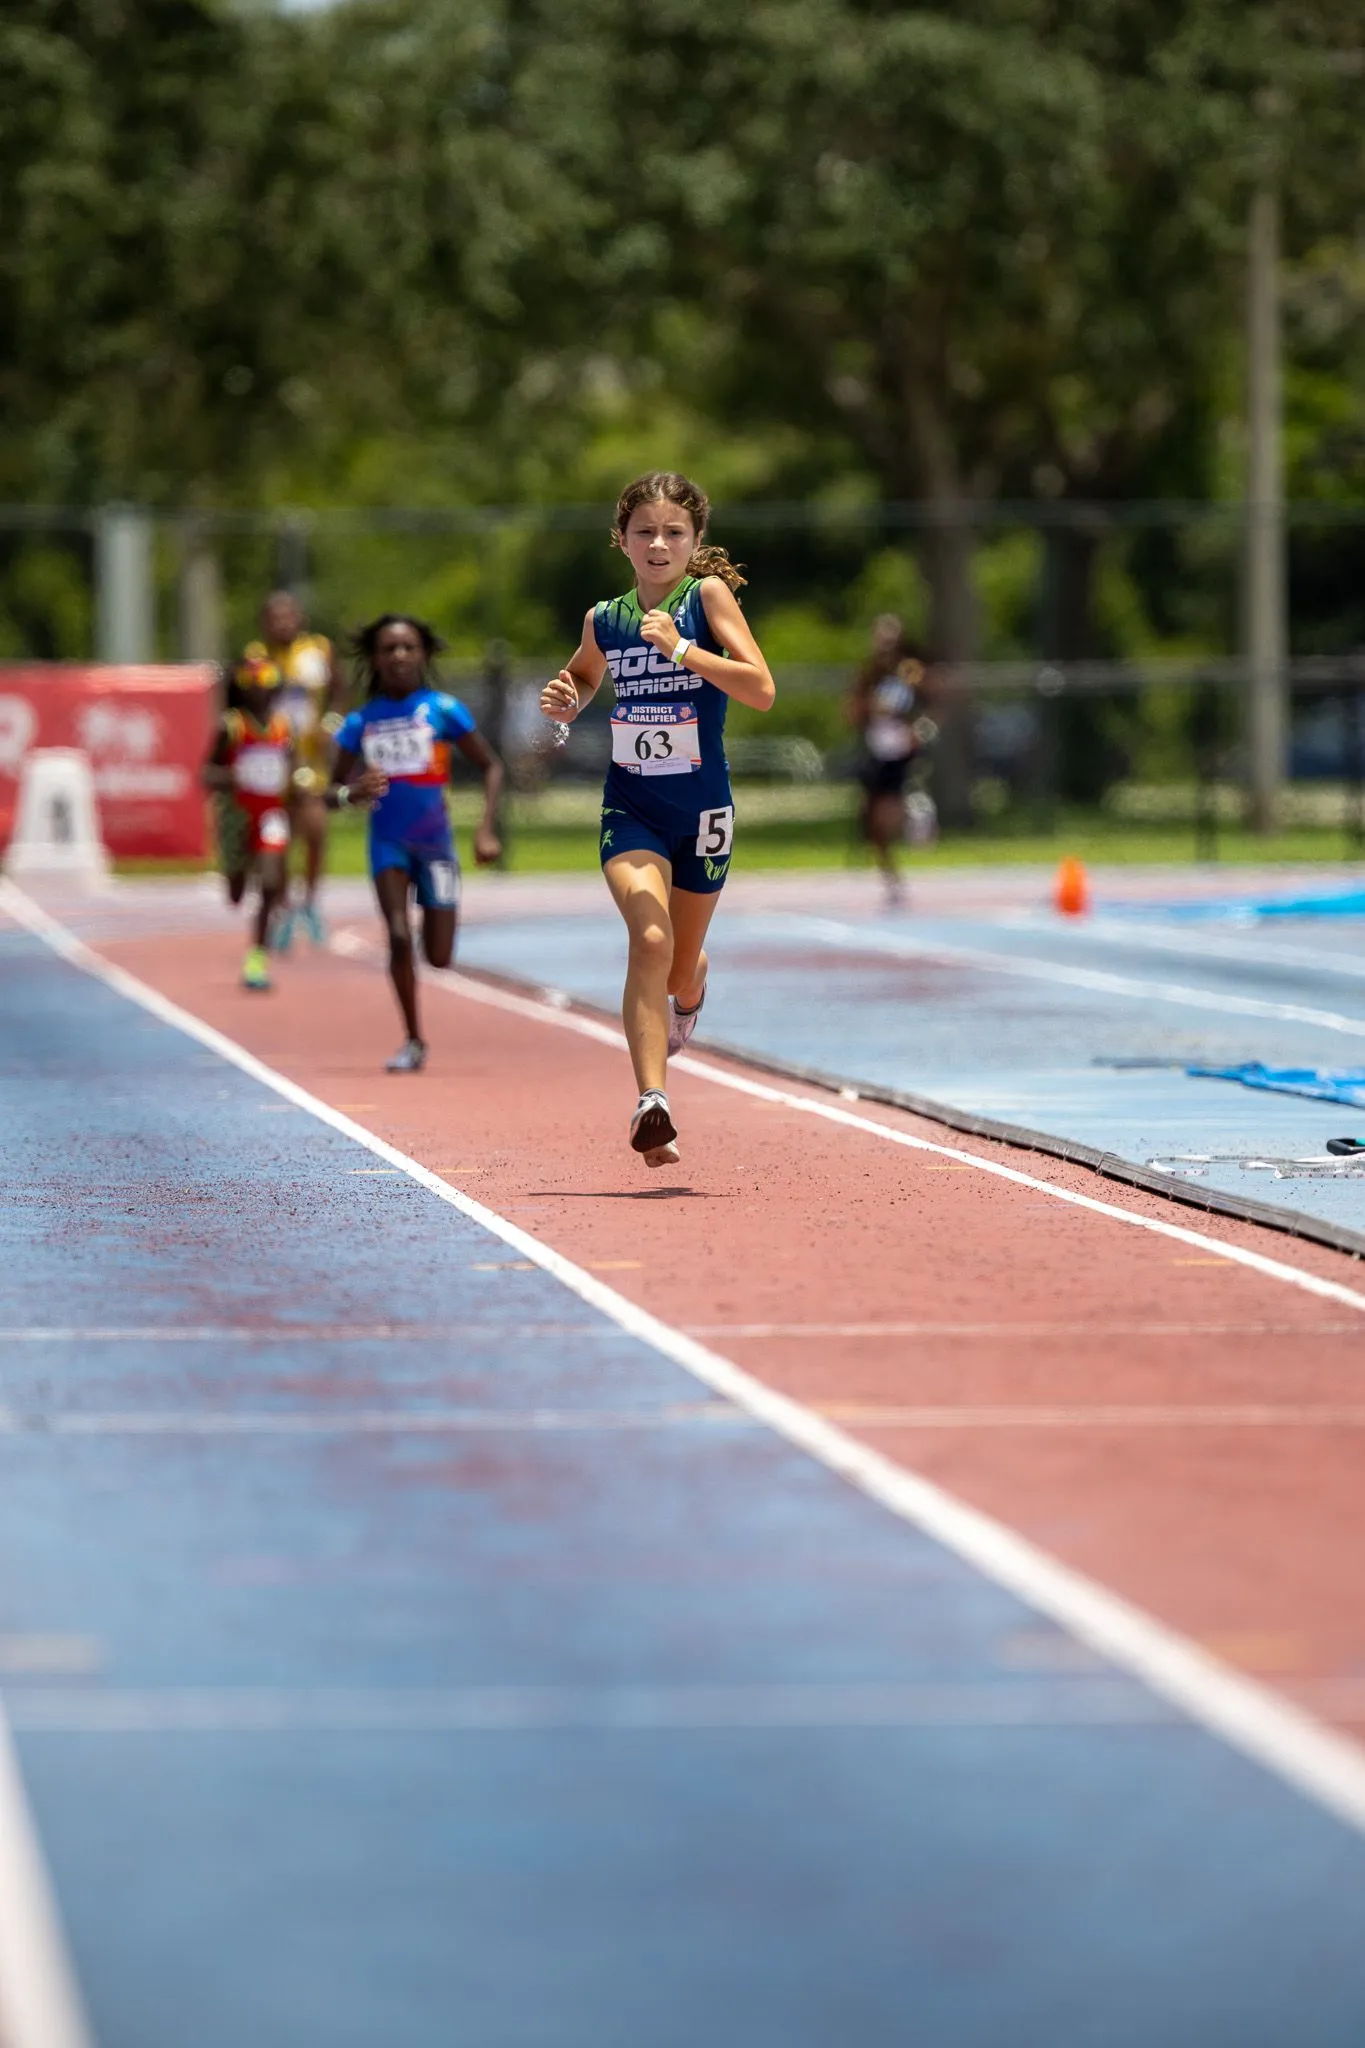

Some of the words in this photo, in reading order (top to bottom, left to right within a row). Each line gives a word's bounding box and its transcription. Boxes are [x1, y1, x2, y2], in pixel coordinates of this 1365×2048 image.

[606, 639, 697, 678] BOC
[627, 714, 677, 722] QUALIFIER
[632, 706, 673, 714] DISTRICT
[635, 730, 672, 760] 63
[705, 812, 726, 854] 5
